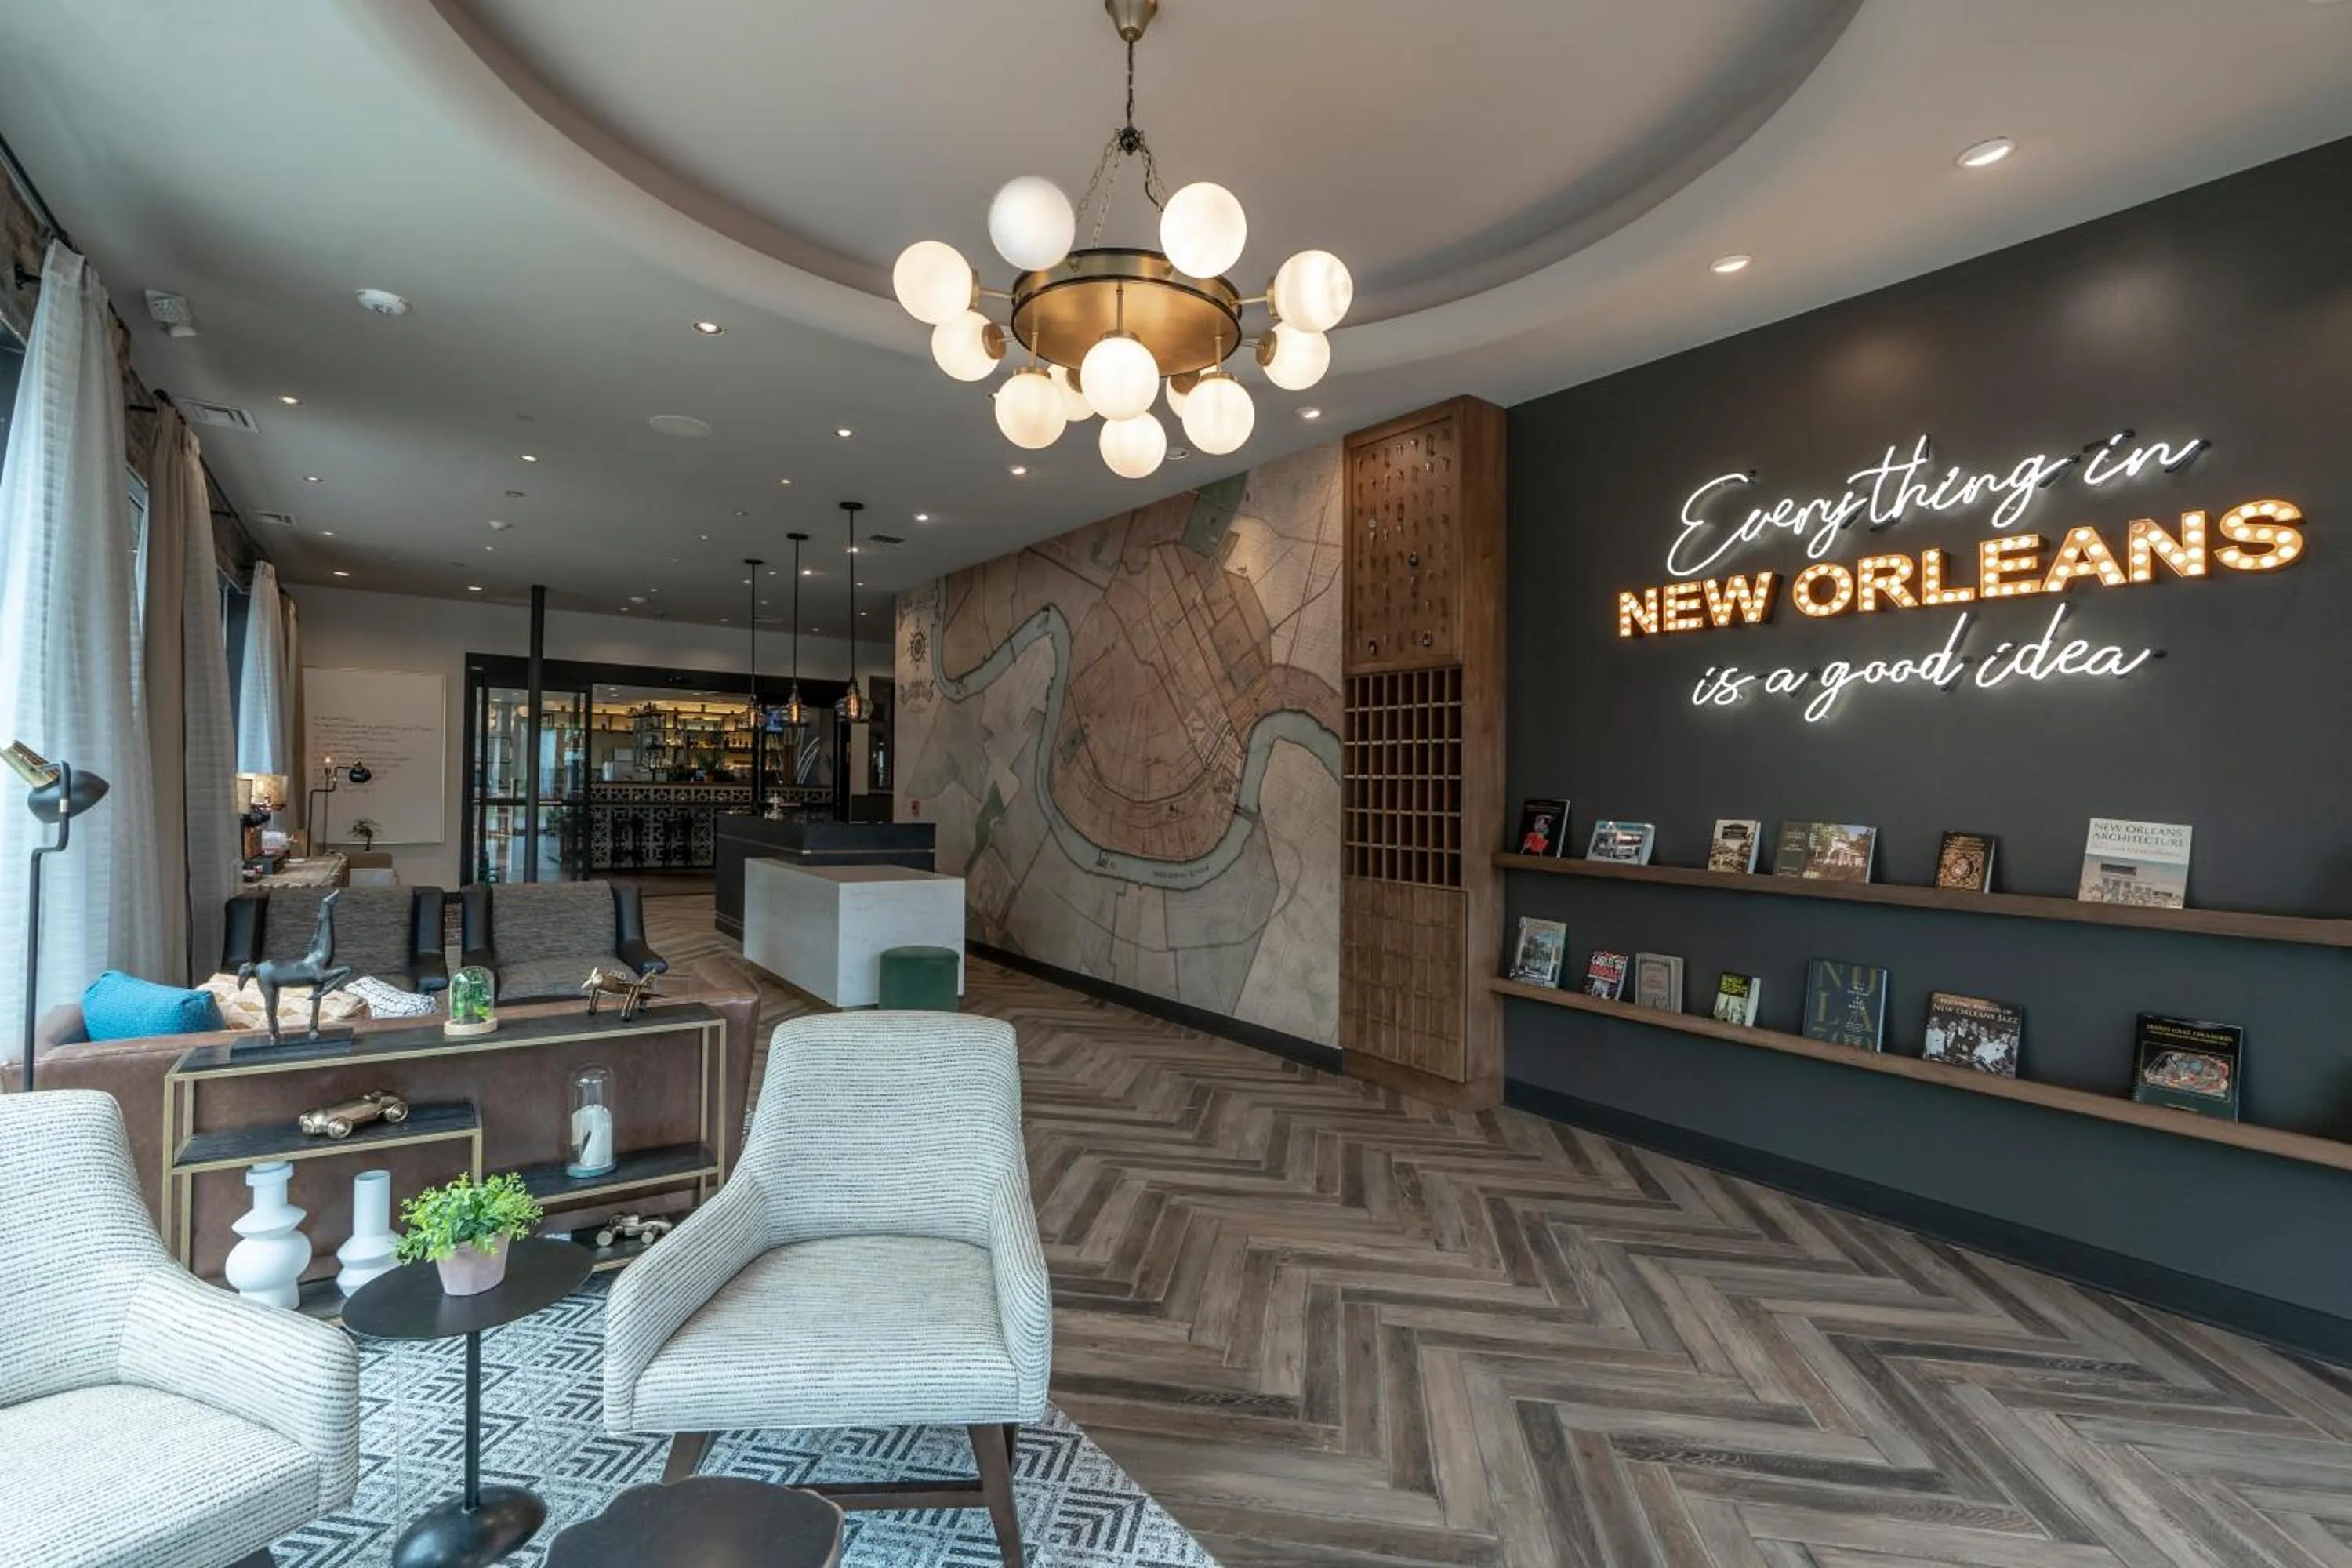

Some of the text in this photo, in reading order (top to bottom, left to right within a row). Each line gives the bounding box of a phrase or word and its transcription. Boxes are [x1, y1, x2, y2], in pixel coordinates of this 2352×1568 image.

[1667, 433, 2199, 575] Everything in
[1618, 499, 2304, 637] NEW ORLEANS
[1692, 601, 2151, 723] is a good idea
[2094, 822, 2183, 837] NEW ORLEANS
[2094, 833, 2183, 848] ARCHITECTURE
